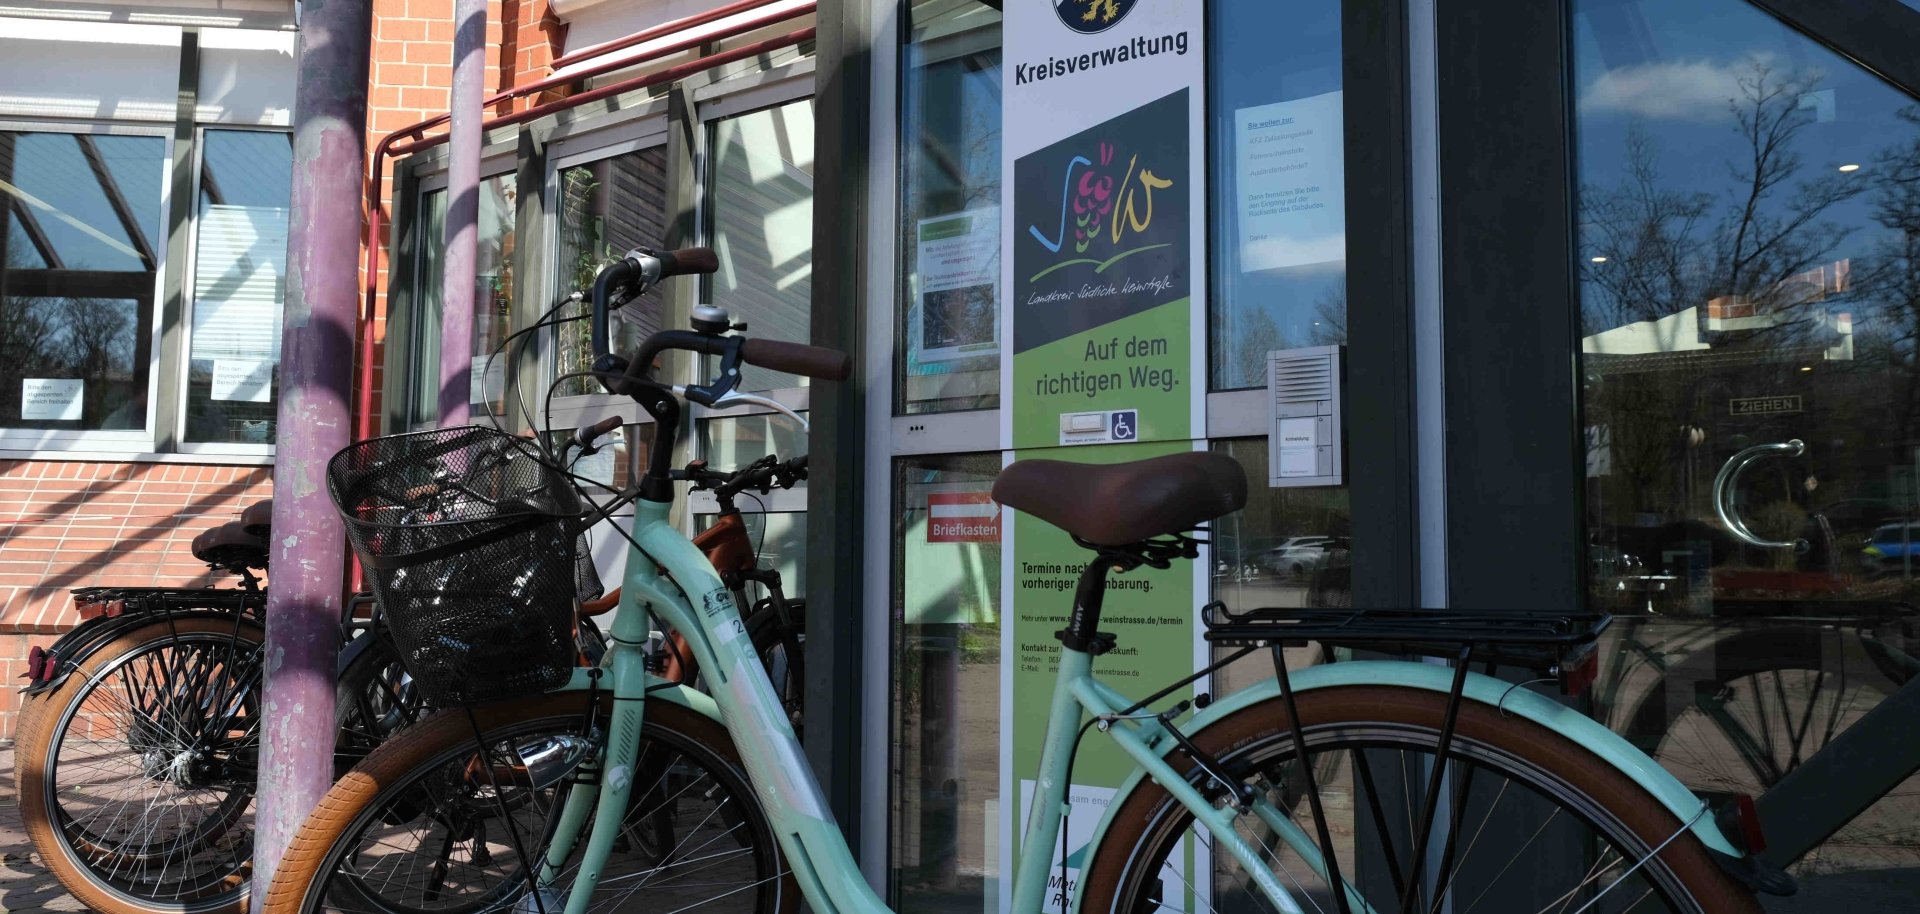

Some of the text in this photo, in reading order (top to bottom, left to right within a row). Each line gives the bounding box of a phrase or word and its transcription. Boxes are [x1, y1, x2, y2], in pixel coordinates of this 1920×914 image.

[1015, 31, 1189, 86] Kreisverwaltung
[1027, 274, 1173, 305] Landkreis Südliche Weinstraße
[1084, 336, 1167, 362] Auf dem
[1036, 365, 1180, 398] richtigen Weg.
[1739, 399, 1793, 412] ZIEHEN
[933, 523, 997, 536] Briefkasten
[1021, 562, 1061, 574] Termine
[1022, 577, 1075, 592] vorheriger
[732, 619, 745, 634] 2
[1021, 643, 1047, 653] Kontakt
[1048, 645, 1060, 653] zur
